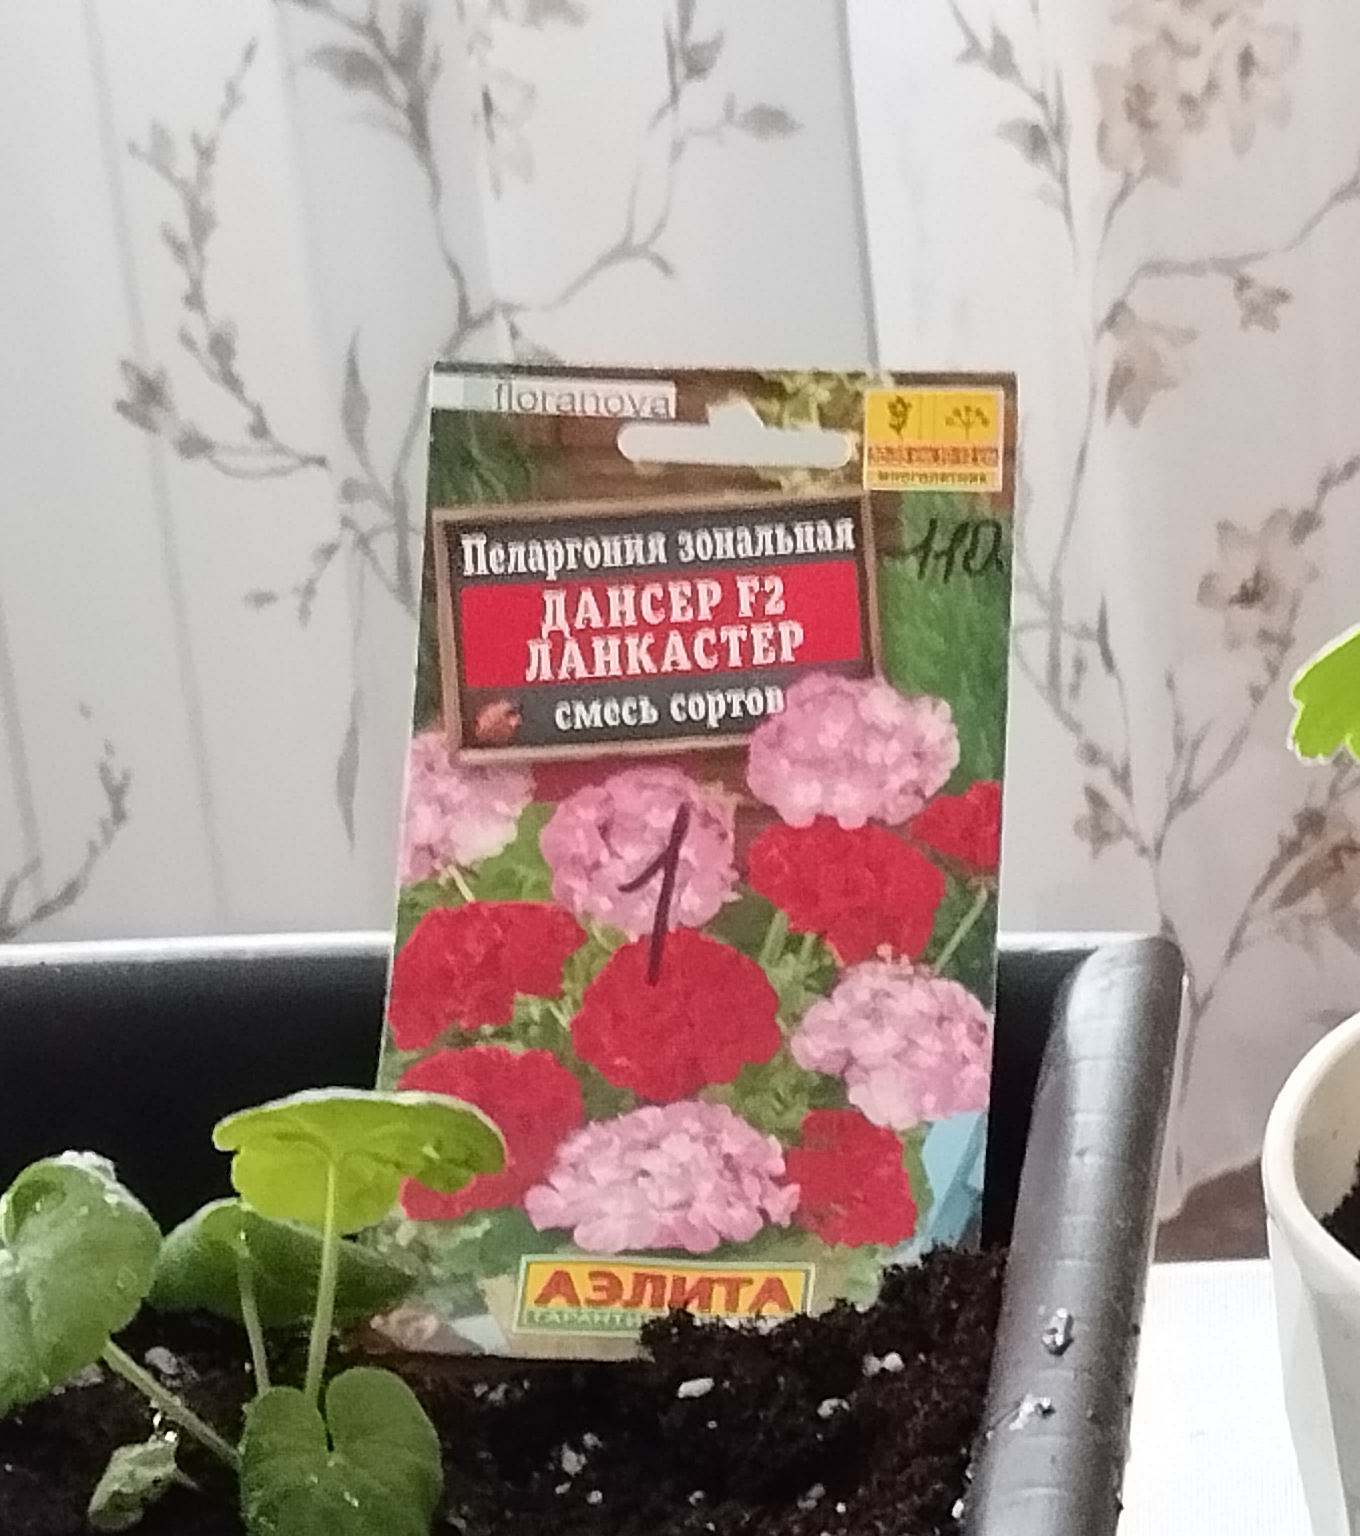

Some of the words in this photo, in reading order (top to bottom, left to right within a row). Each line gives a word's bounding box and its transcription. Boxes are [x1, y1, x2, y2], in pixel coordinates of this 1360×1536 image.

[496, 381, 670, 419] floranova
[460, 531, 668, 581] Пеларгония
[677, 517, 856, 564] зональная
[541, 578, 723, 639] ДАНСЕР
[735, 574, 786, 617] F2
[525, 620, 805, 682] ЛАНКАСТЕР
[554, 693, 659, 731] смесь
[670, 685, 786, 728] сортов
[618, 801, 691, 987] 1
[533, 1269, 795, 1314] АЭЛИТА
